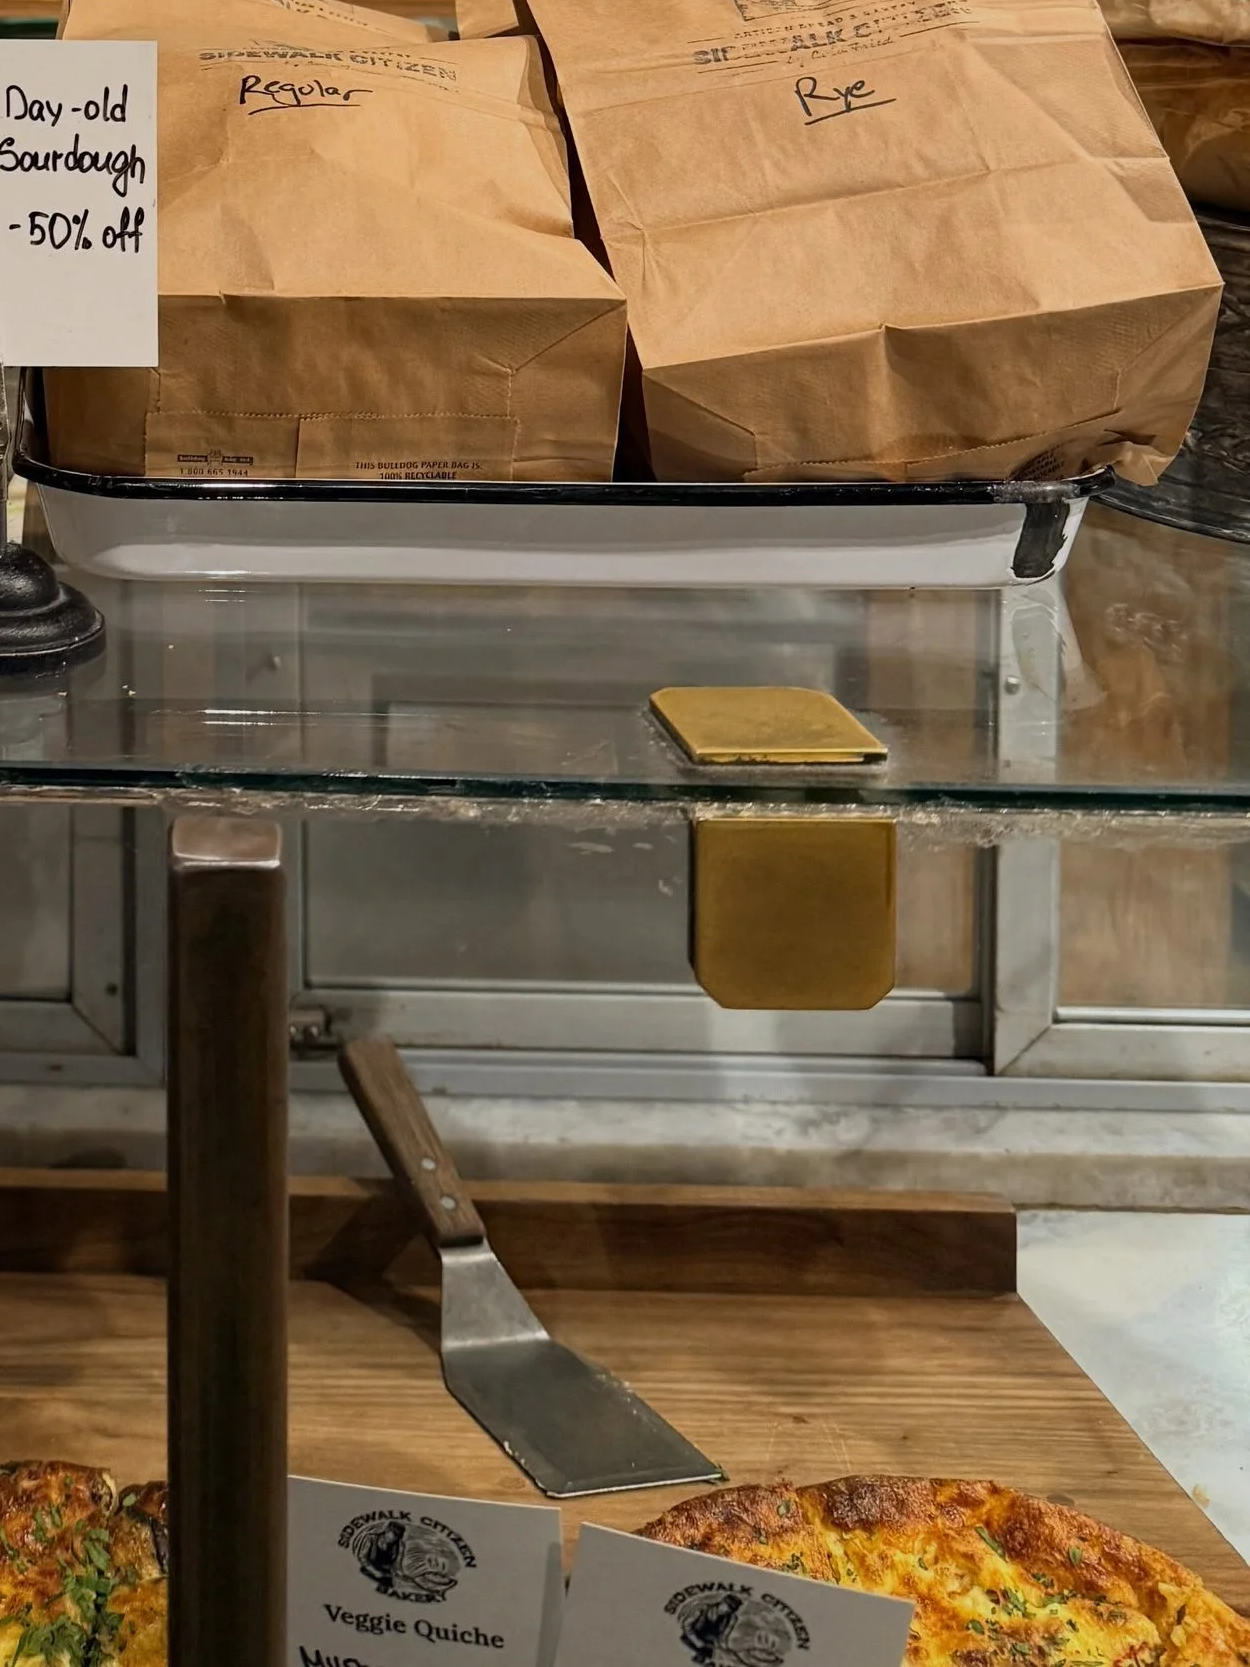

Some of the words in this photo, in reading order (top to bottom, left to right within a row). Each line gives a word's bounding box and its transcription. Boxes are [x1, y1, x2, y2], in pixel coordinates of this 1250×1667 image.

[348, 52, 458, 80] CITIZEN
[239, 74, 374, 106] Regular
[794, 76, 876, 117] Rye
[102, 206, 145, 253] off
[355, 462, 375, 470] THIS
[378, 462, 418, 470] BULLDOG
[337, 1509, 412, 1550] SIDEWALK
[420, 1516, 477, 1569] CITIZEN
[375, 1585, 447, 1604] BAKERY
[323, 1603, 406, 1635] Veggie
[414, 1619, 505, 1649] Quiche
[663, 1582, 753, 1615] SIDEWALK
[761, 1593, 811, 1650] CITIZEN
